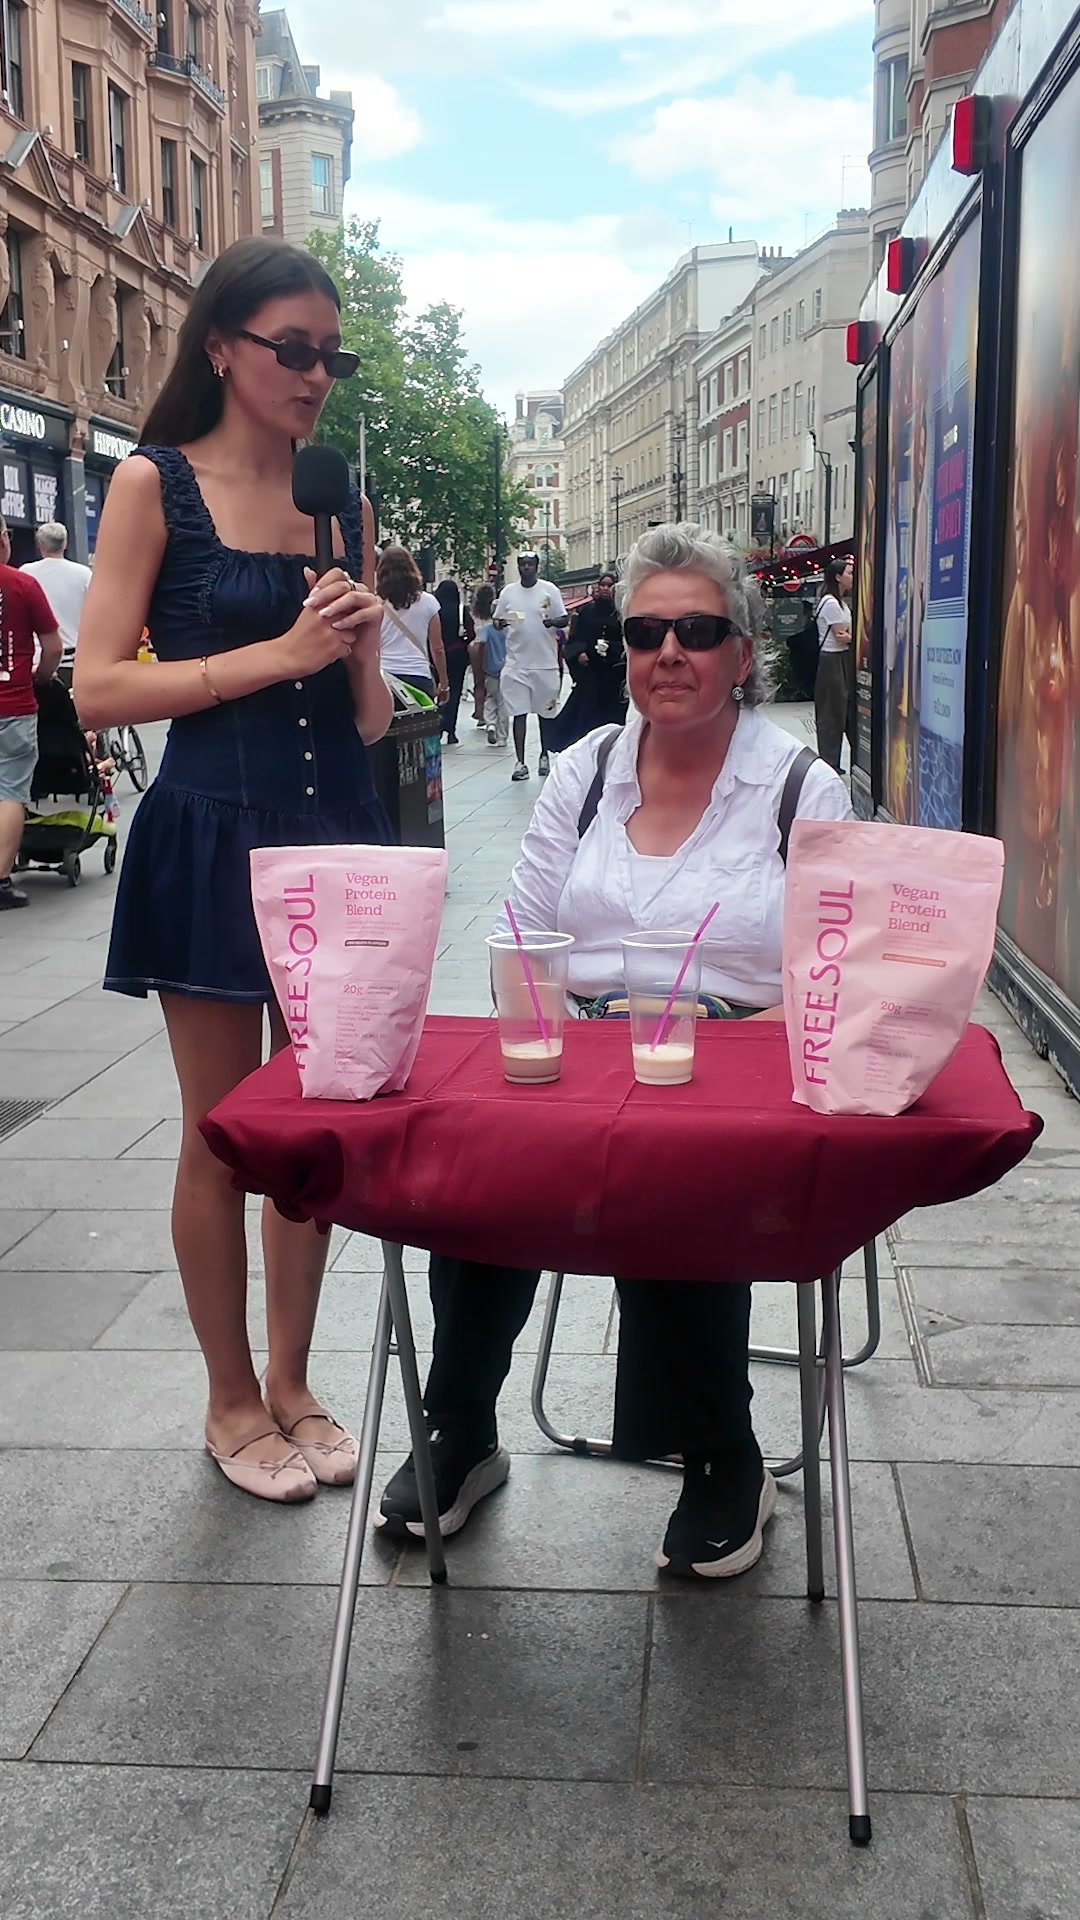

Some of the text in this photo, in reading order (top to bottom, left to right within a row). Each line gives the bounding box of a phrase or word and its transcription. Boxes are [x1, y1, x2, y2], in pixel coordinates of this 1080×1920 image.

[0, 403, 45, 439] CASINO
[1, 491, 25, 518] OFFICE
[345, 872, 389, 887] Vegan
[344, 888, 397, 901] Protein
[893, 883, 940, 901] Vegan
[346, 904, 383, 916] Blend
[890, 900, 946, 919] Protein
[888, 917, 930, 933] Blend
[343, 984, 364, 996] 20g
[881, 1001, 902, 1016] 20g
